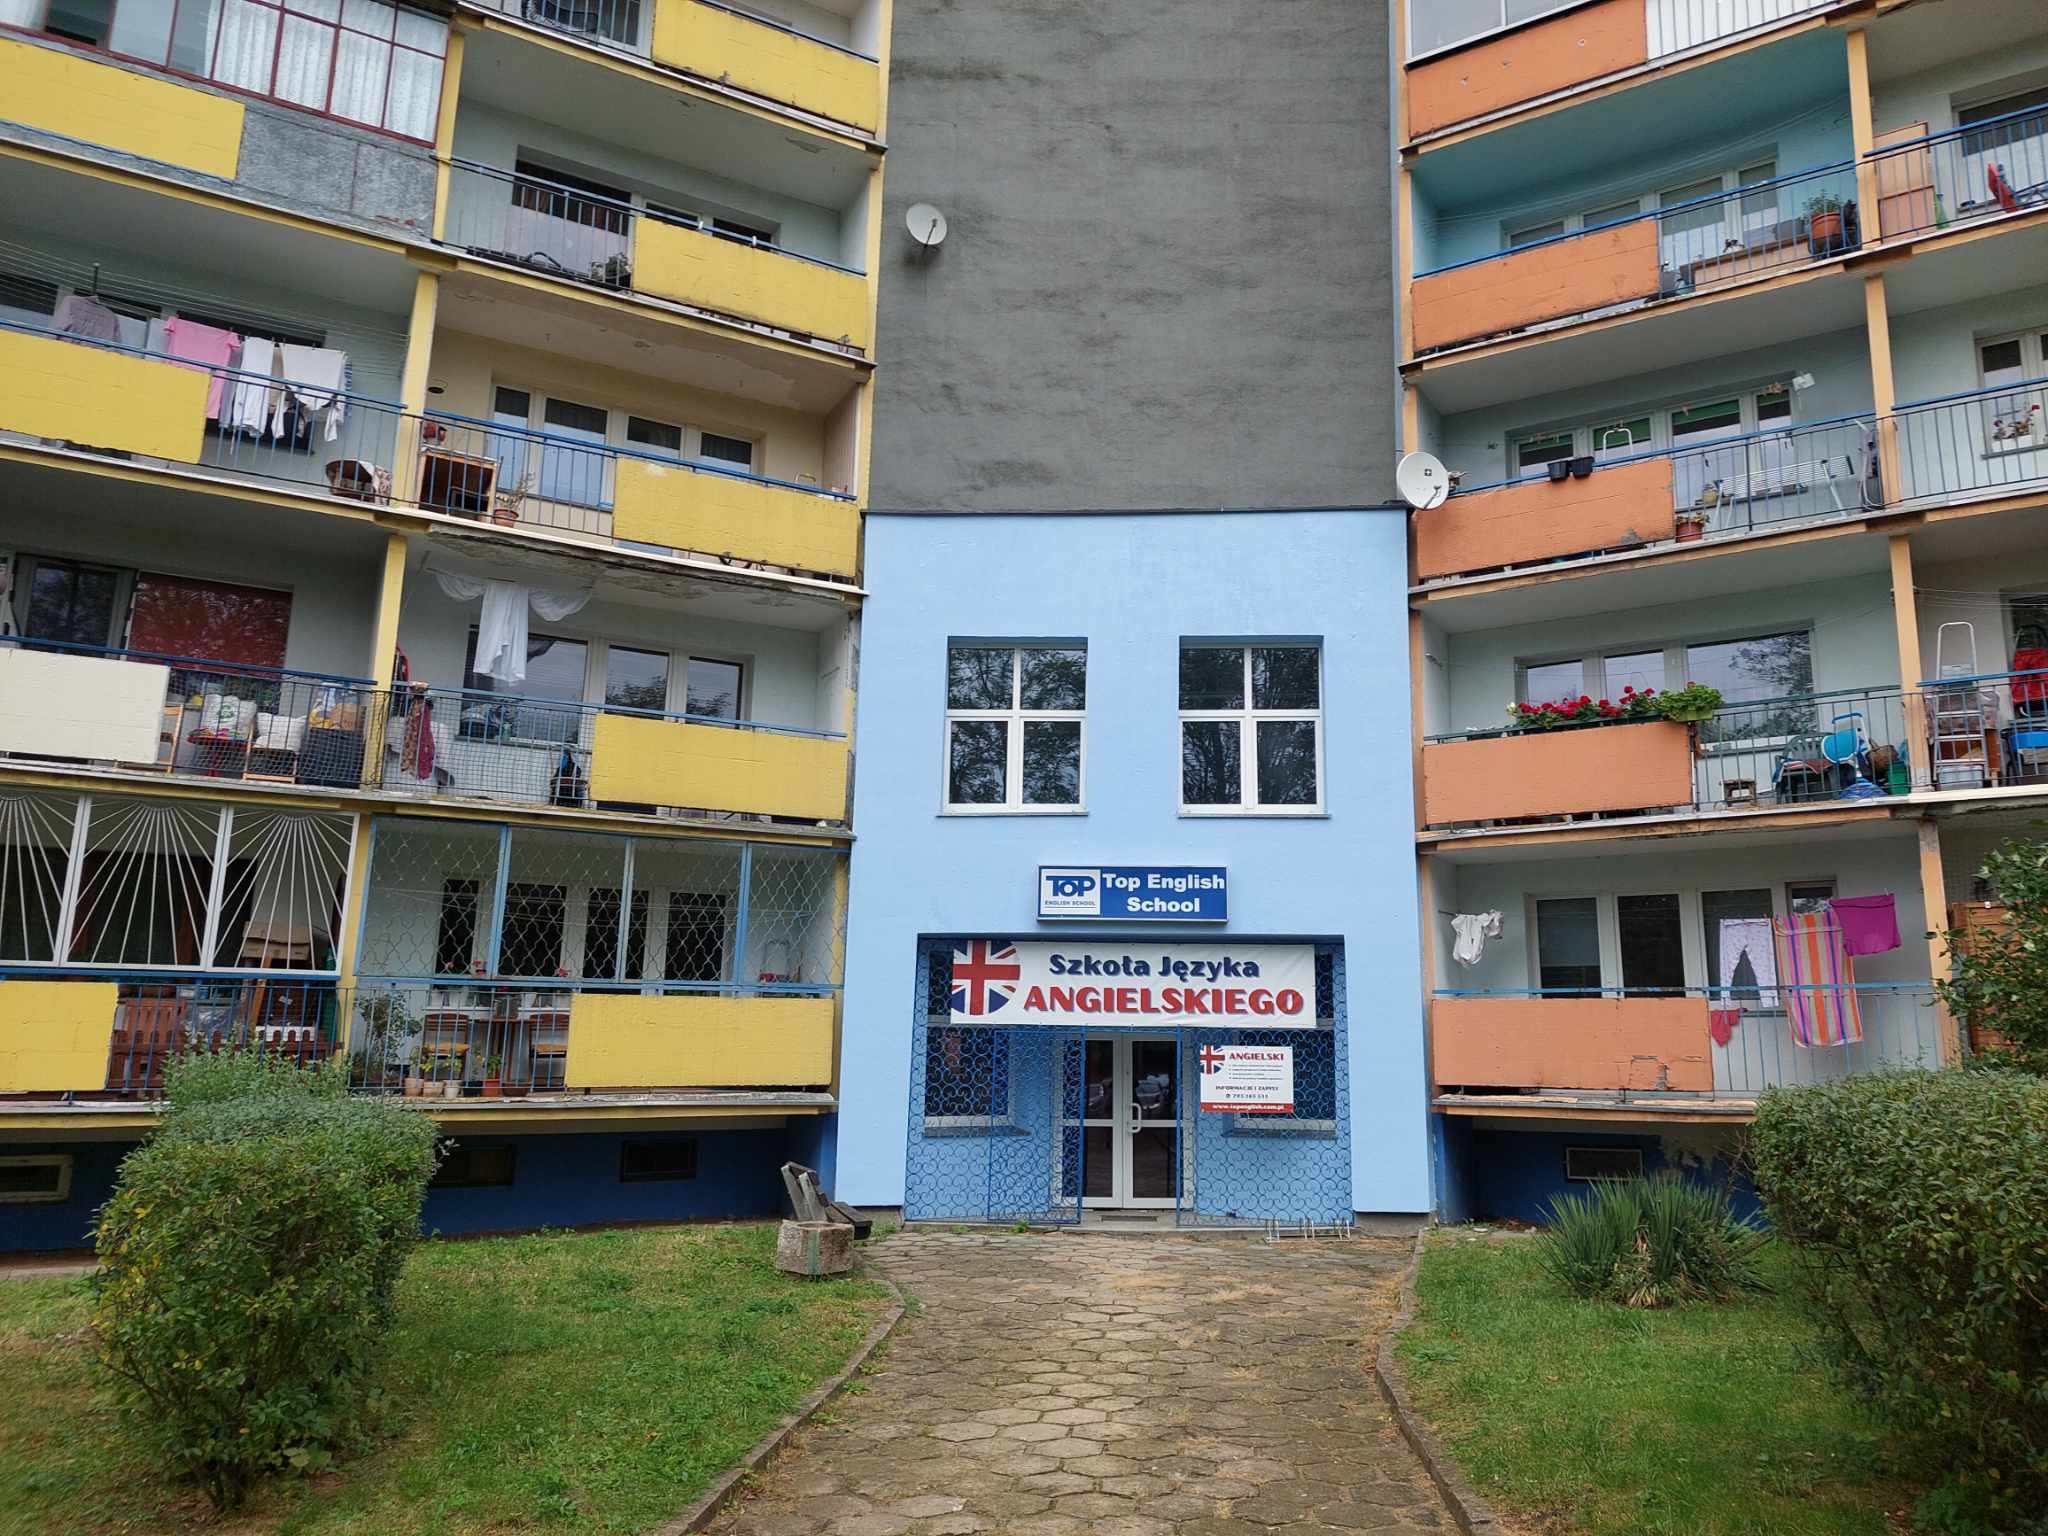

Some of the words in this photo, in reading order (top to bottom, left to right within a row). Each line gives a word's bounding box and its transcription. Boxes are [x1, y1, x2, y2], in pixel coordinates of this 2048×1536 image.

[1045, 875, 1096, 897] TOP
[1102, 873, 1141, 892] Top
[1147, 873, 1226, 892] English
[1127, 896, 1201, 913] School
[1049, 953, 1152, 977] Szkoła
[1158, 956, 1261, 982] Języka
[1023, 985, 1305, 1015] ANGIELSKIEGO
[1229, 1052, 1284, 1061] ANGIELSKI
